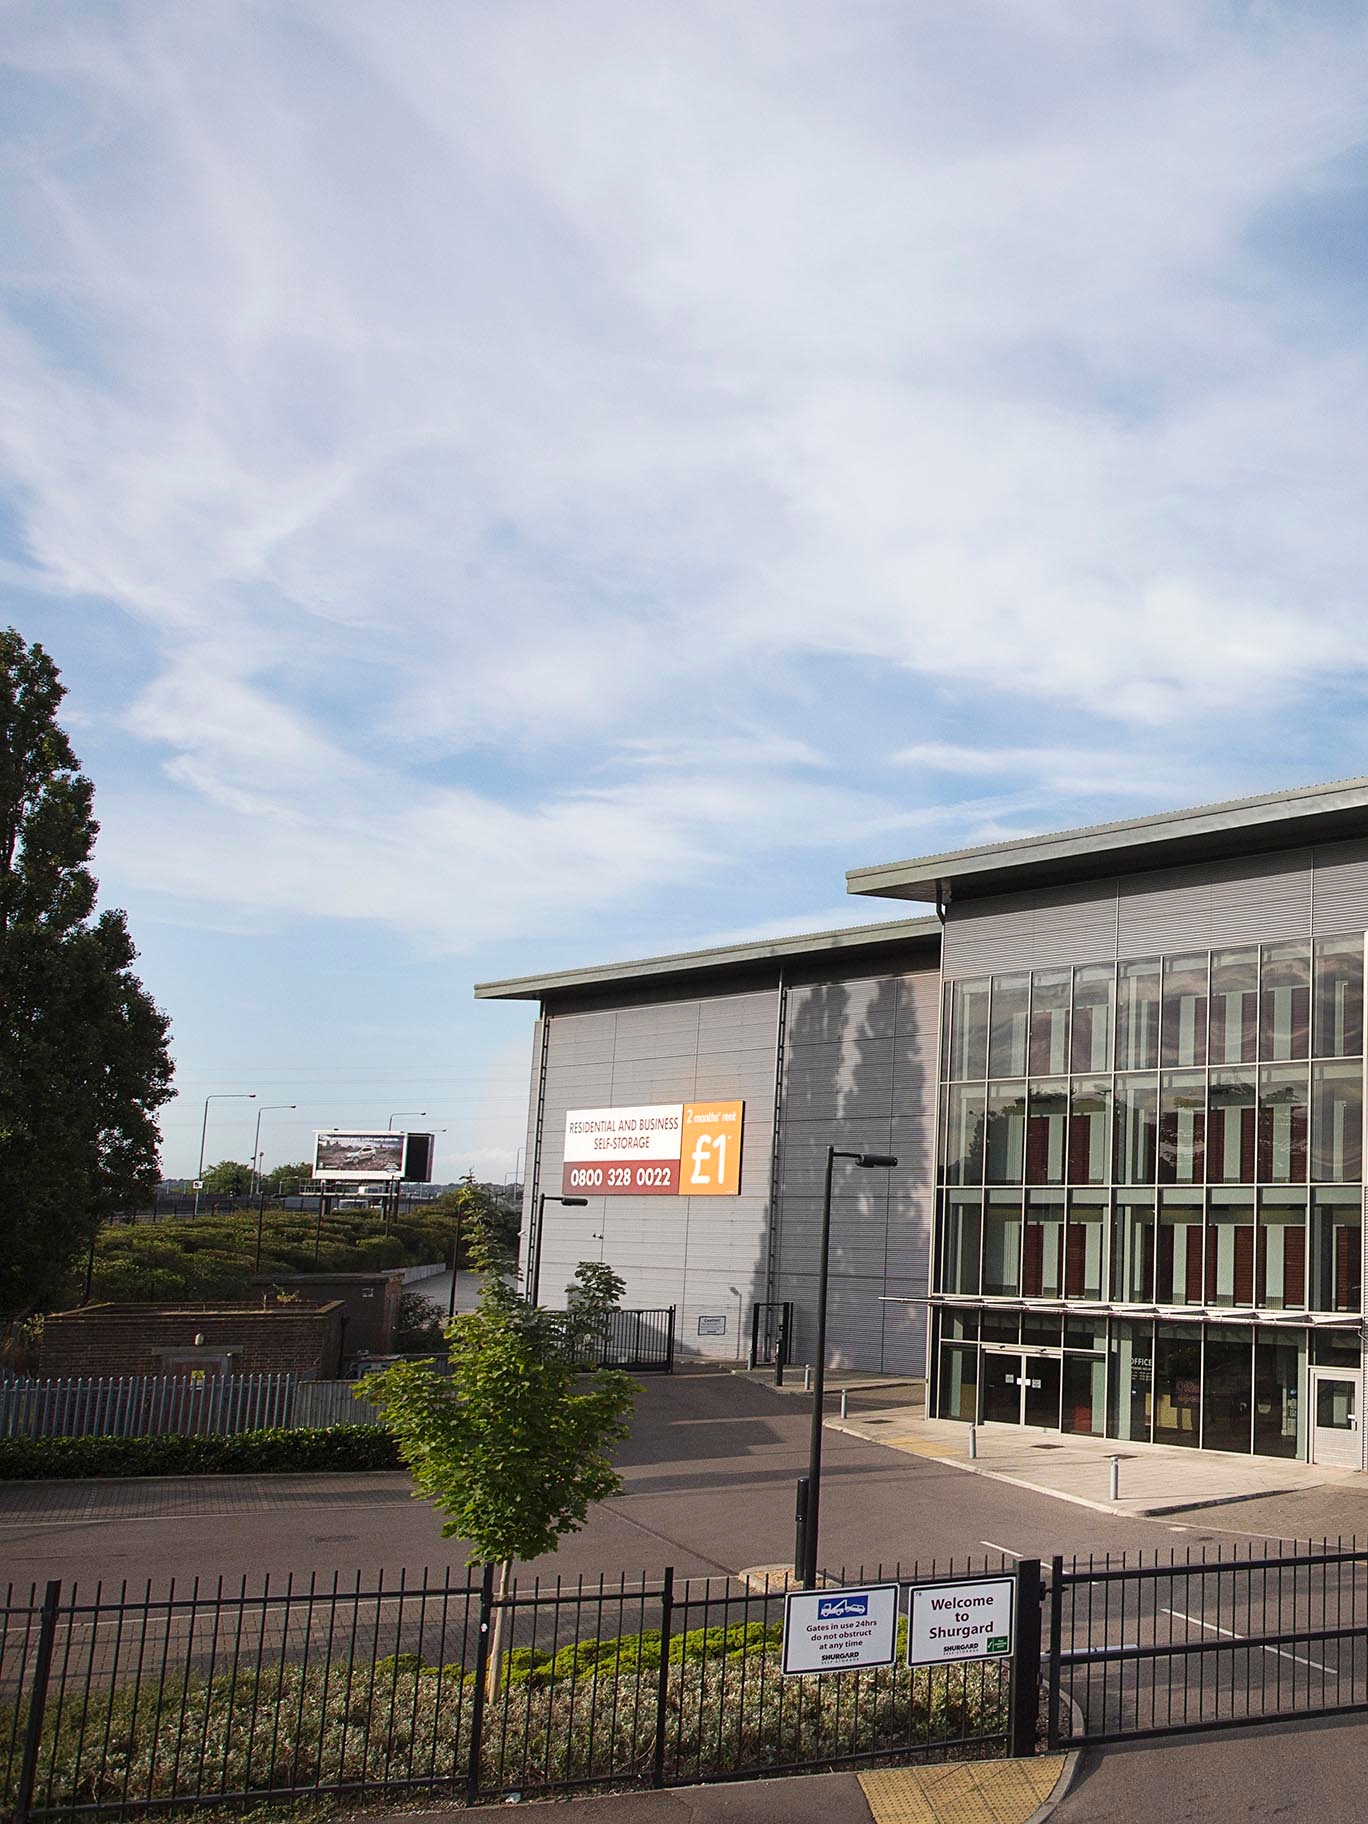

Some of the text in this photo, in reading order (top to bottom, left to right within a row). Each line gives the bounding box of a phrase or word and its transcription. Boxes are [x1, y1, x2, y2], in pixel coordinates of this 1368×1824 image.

[686, 1109, 693, 1124] 2
[722, 1111, 736, 1122] rent
[569, 1117, 679, 1134] RESIDENTIAL AND BUSINESS
[593, 1136, 650, 1150] SELF-STORAGE
[570, 1167, 671, 1187] 0800 328 0022
[1130, 1357, 1152, 1366] OFFICE
[931, 1596, 994, 1611] Welcome
[955, 1612, 969, 1622] to
[806, 1623, 829, 1632] Gates
[855, 1619, 877, 1628] 24hrs
[929, 1621, 994, 1639] Shurgard
[838, 1630, 872, 1639] obstruct
[829, 1642, 843, 1650] any
[845, 1640, 863, 1648] time
[943, 1643, 979, 1653] SHURGARD
[821, 1651, 859, 1661] SHURGARD
